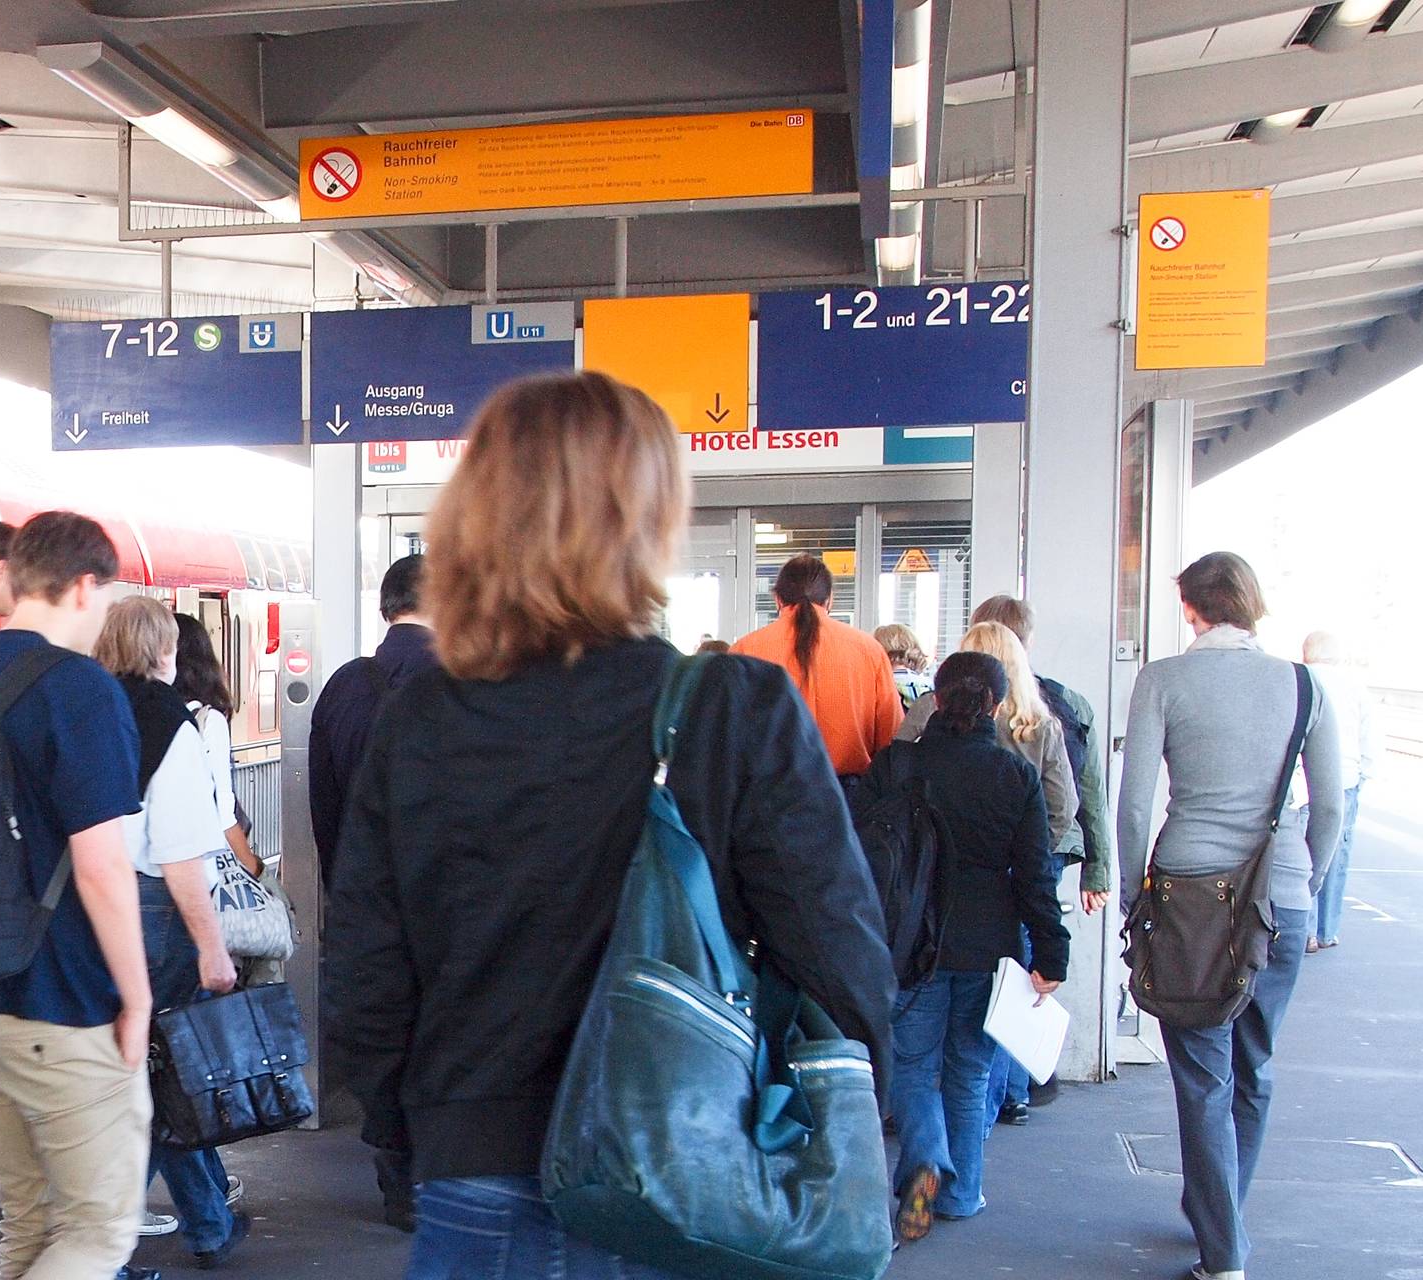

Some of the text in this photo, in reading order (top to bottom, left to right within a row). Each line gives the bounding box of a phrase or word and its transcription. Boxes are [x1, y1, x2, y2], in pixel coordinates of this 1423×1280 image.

[750, 119, 783, 128] Die Bahn
[788, 115, 803, 126] DB
[384, 138, 458, 152] Rauchfreier
[384, 153, 436, 168] Bahnhof
[384, 174, 458, 188] Non-Smoking
[384, 189, 423, 200] Station
[815, 290, 878, 331] 1-2
[886, 312, 915, 328] und
[491, 313, 510, 339] U
[101, 320, 179, 359] 7-12
[365, 384, 425, 400] Ausgang
[101, 410, 150, 425] Freiheit
[364, 402, 455, 418] Messe/Gruga
[690, 427, 839, 452] Hotel Essen
[374, 442, 401, 457] ibis
